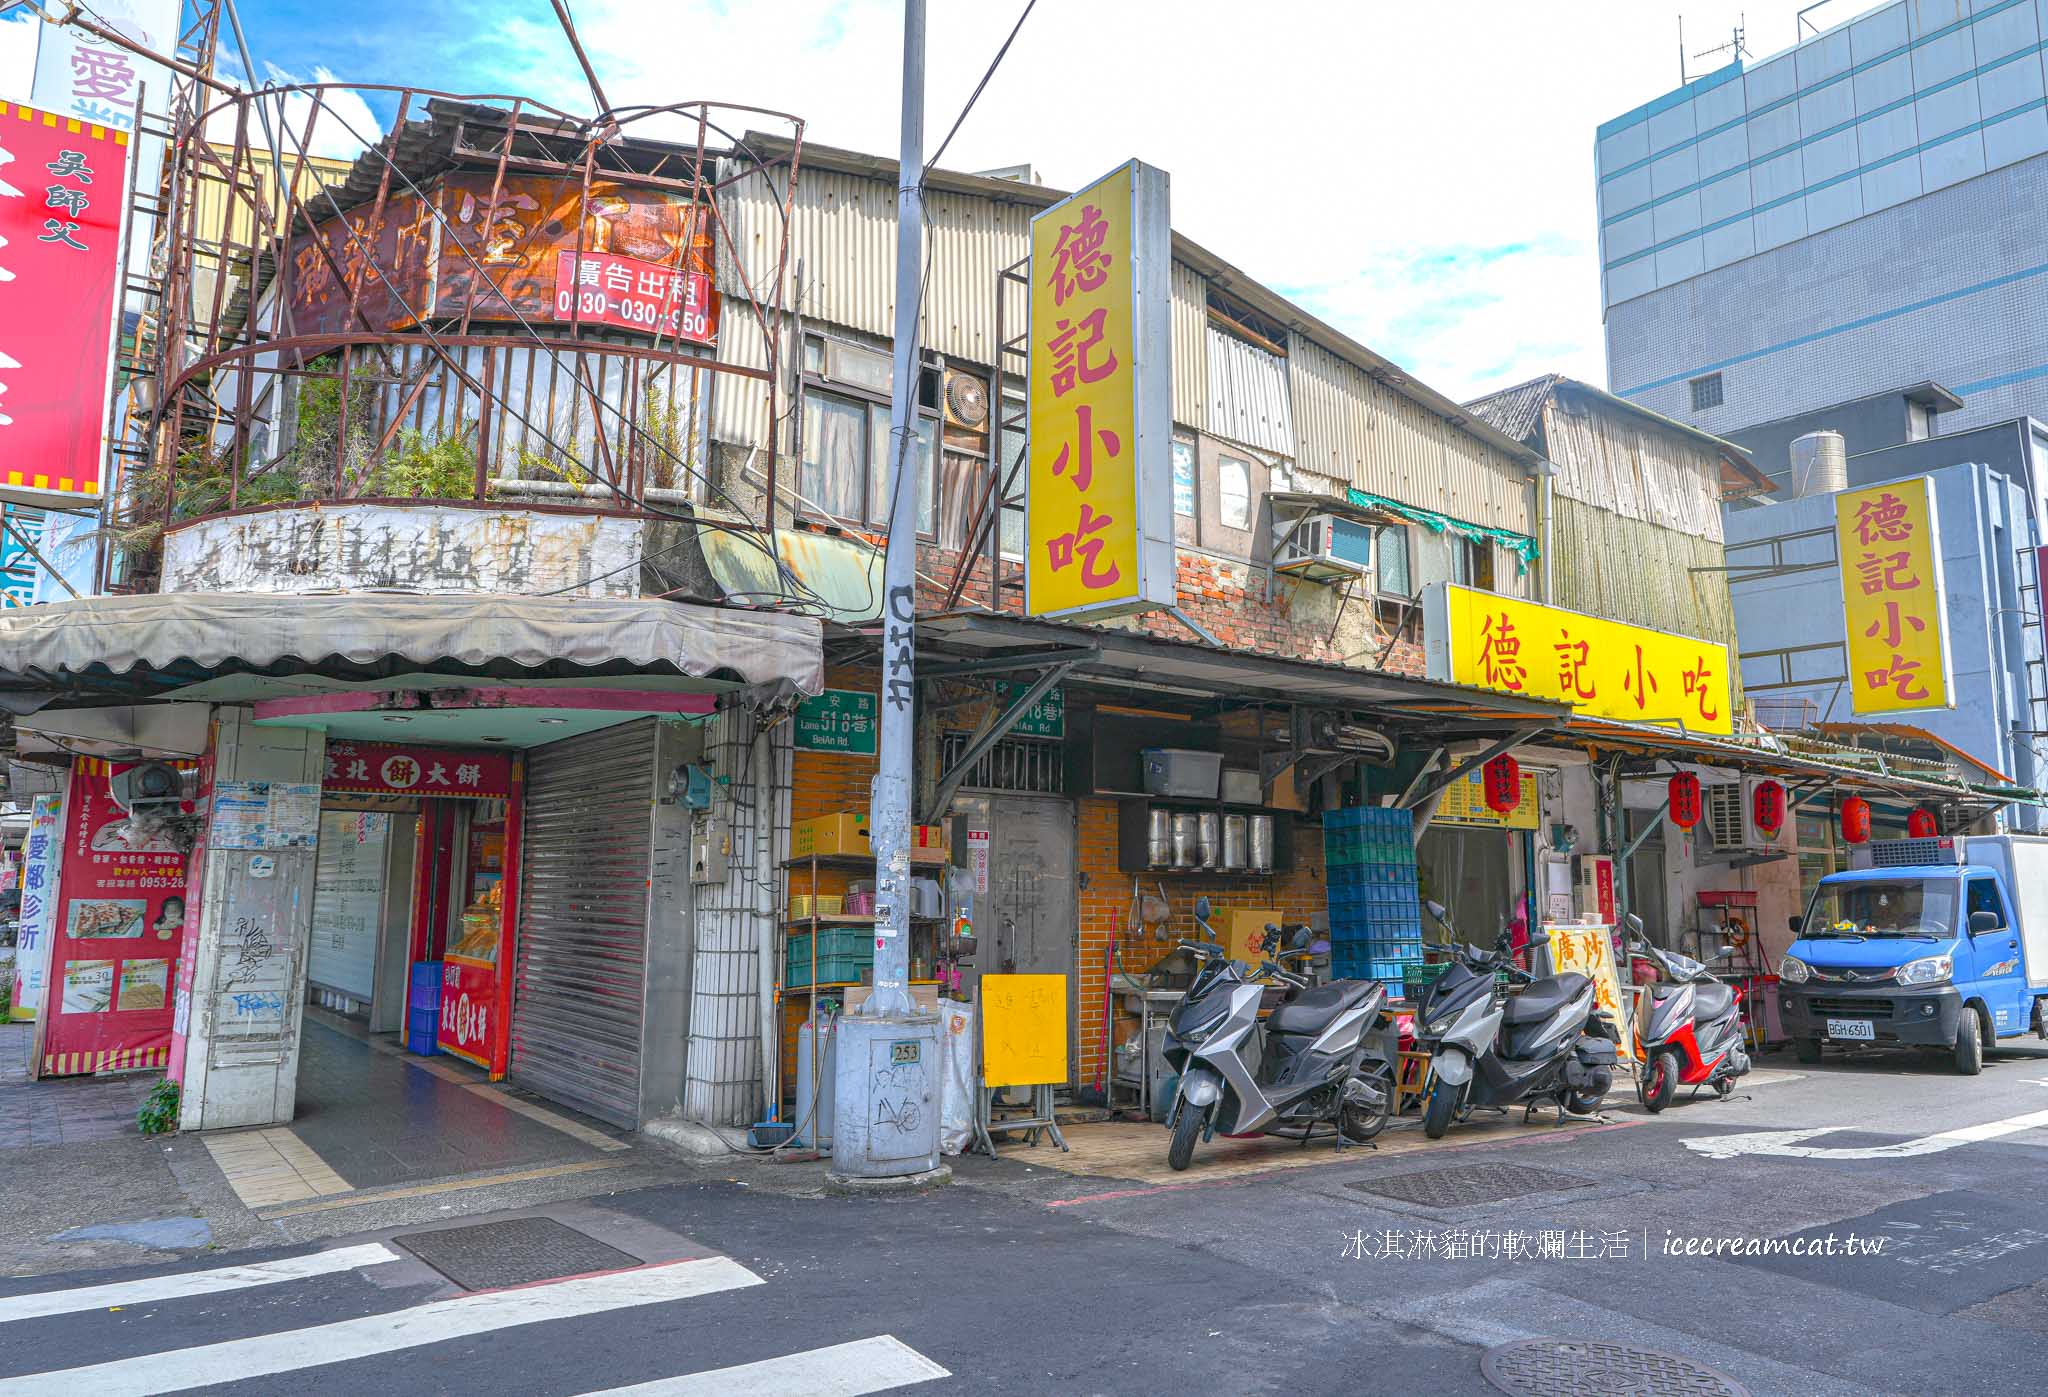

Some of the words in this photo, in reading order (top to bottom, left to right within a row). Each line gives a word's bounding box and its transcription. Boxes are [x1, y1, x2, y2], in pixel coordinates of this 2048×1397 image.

[37, 150, 94, 251] 吳師父
[570, 259, 698, 307] 廣告出租
[1047, 204, 1122, 590] 德記小吃
[1852, 492, 1929, 701] 德記小吃
[1478, 612, 1719, 721] 德記小吃
[800, 719, 820, 731] Lane
[812, 734, 835, 746] BeiAn
[140, 876, 188, 888] 0953-28
[1829, 1022, 1873, 1038] BGH-6301
[895, 1045, 918, 1060] 253
